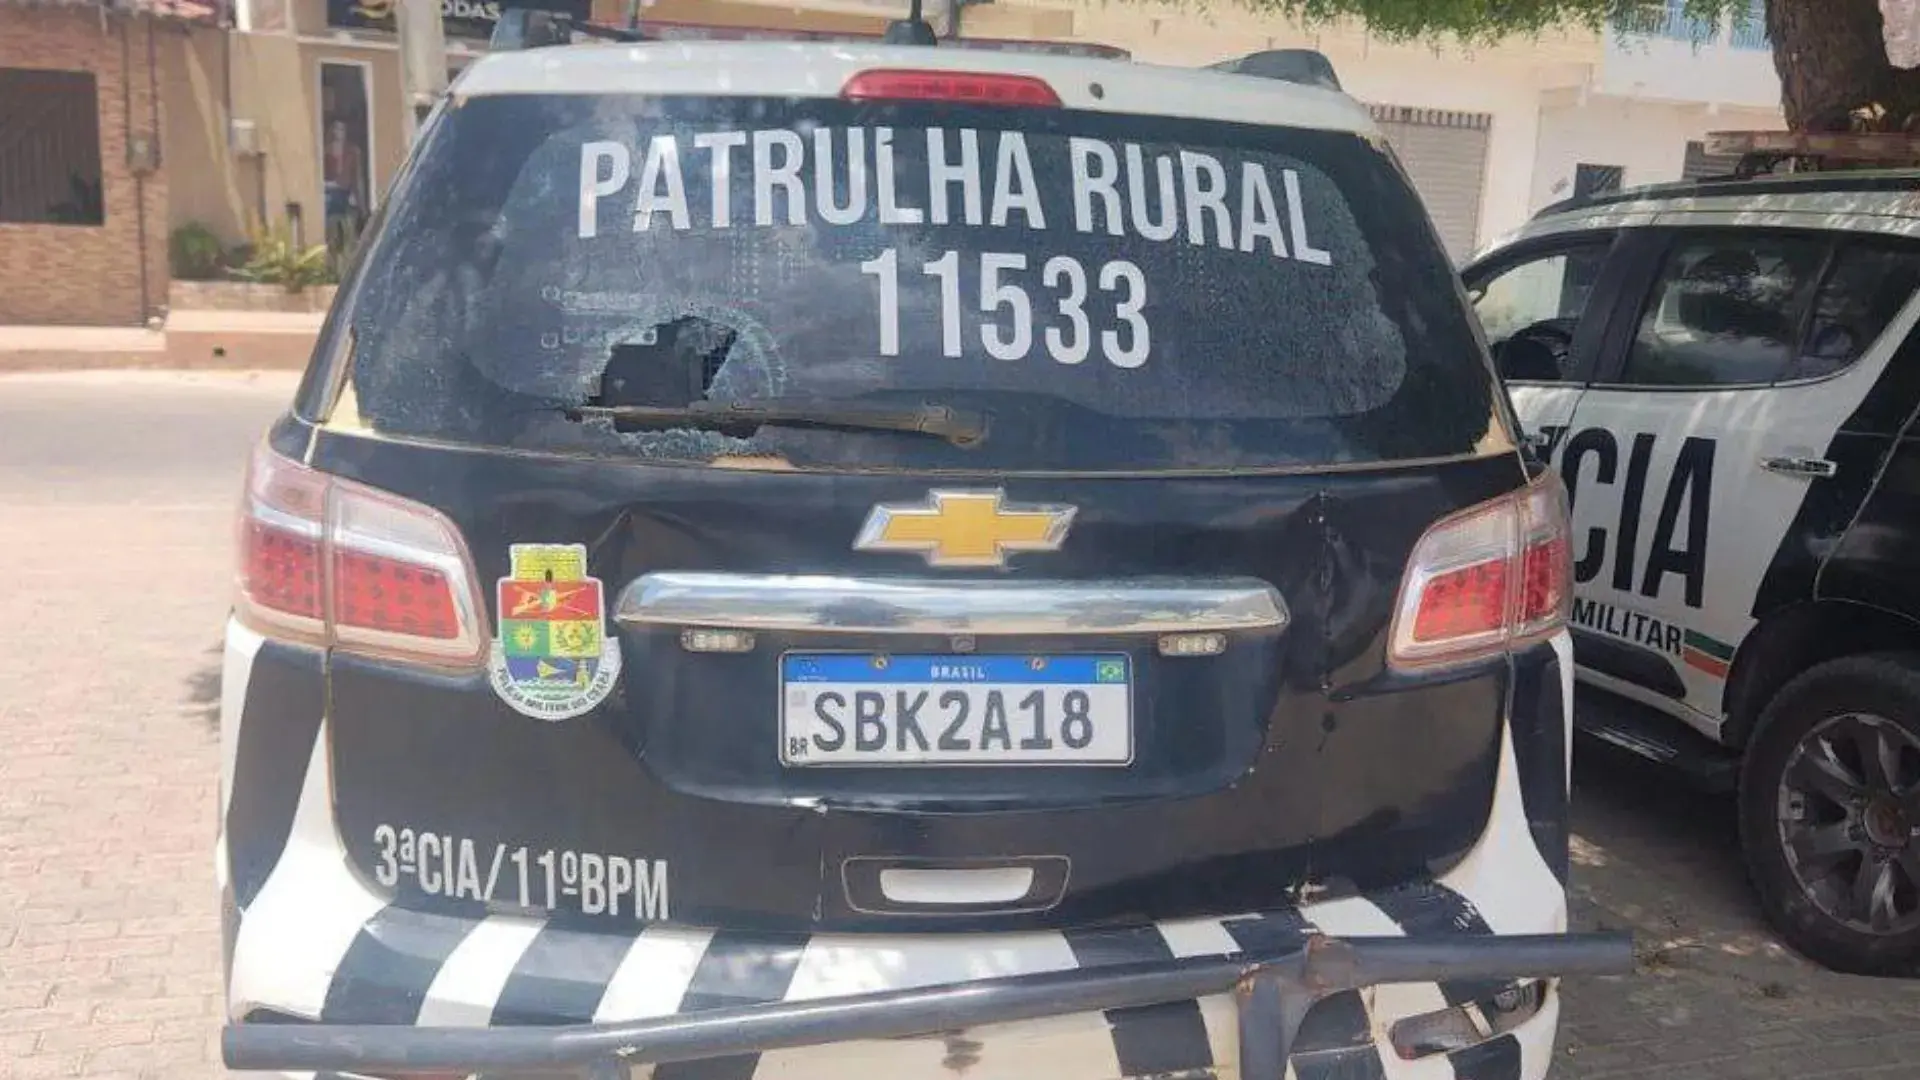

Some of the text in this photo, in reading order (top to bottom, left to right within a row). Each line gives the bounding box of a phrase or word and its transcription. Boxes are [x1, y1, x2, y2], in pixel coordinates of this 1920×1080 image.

[440, 0, 501, 20] ODAS
[577, 126, 1332, 267] PATRULHA RURAL
[861, 248, 1151, 369] 11533
[1538, 426, 1717, 609] CIA
[1572, 597, 1683, 656] MILITAR
[930, 665, 985, 680] BRASIL
[789, 736, 808, 757] BR
[812, 689, 1093, 752] SBK2A18
